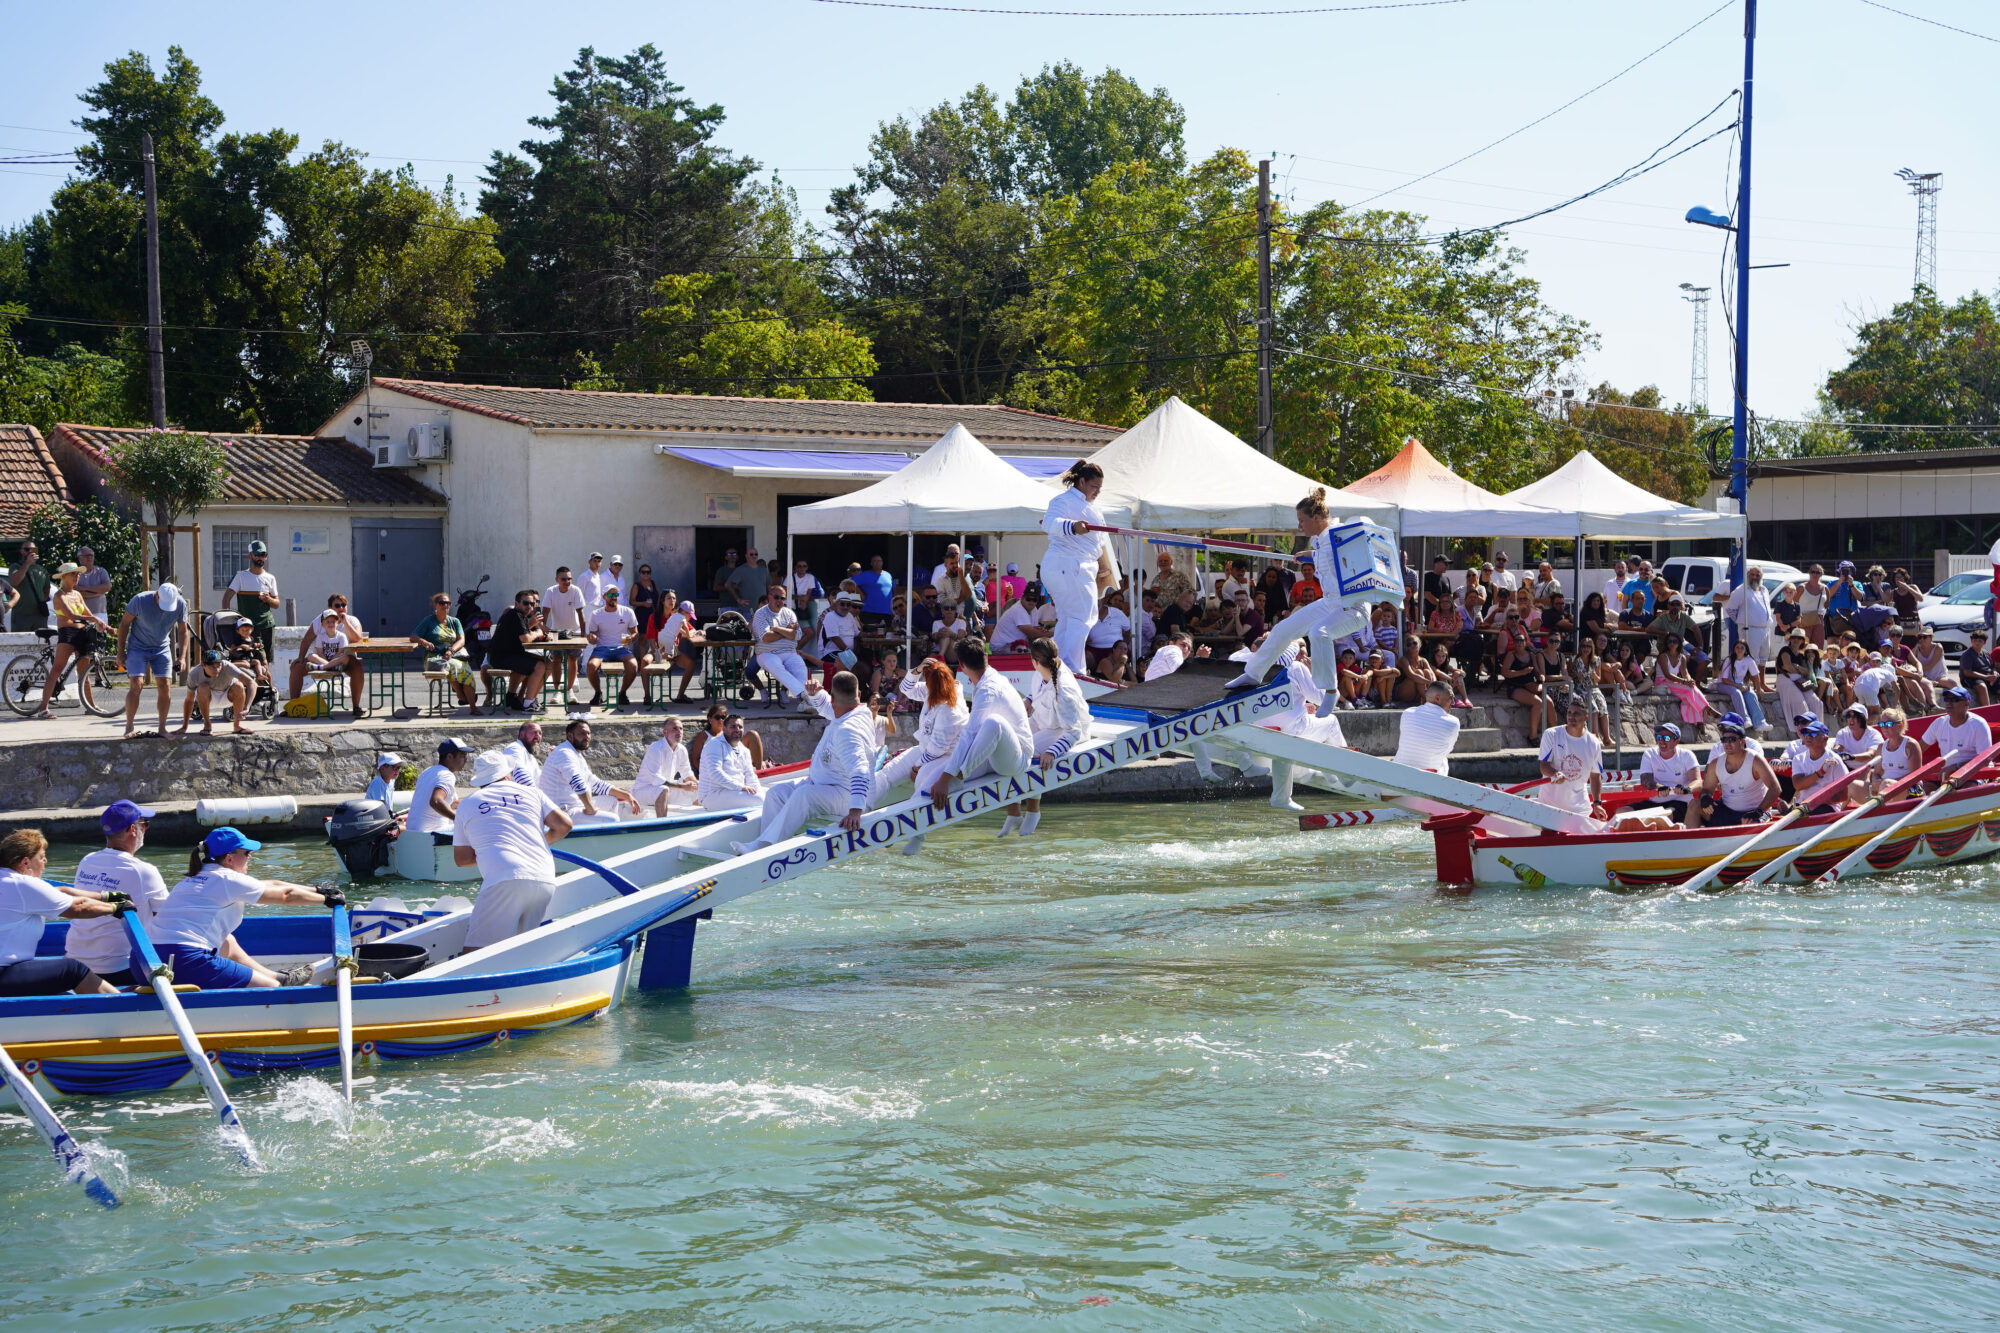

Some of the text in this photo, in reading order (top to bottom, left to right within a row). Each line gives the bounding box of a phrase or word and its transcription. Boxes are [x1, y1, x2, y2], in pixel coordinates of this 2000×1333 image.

[825, 701, 1246, 862] FRONTIGNAN SON MUSCAT
